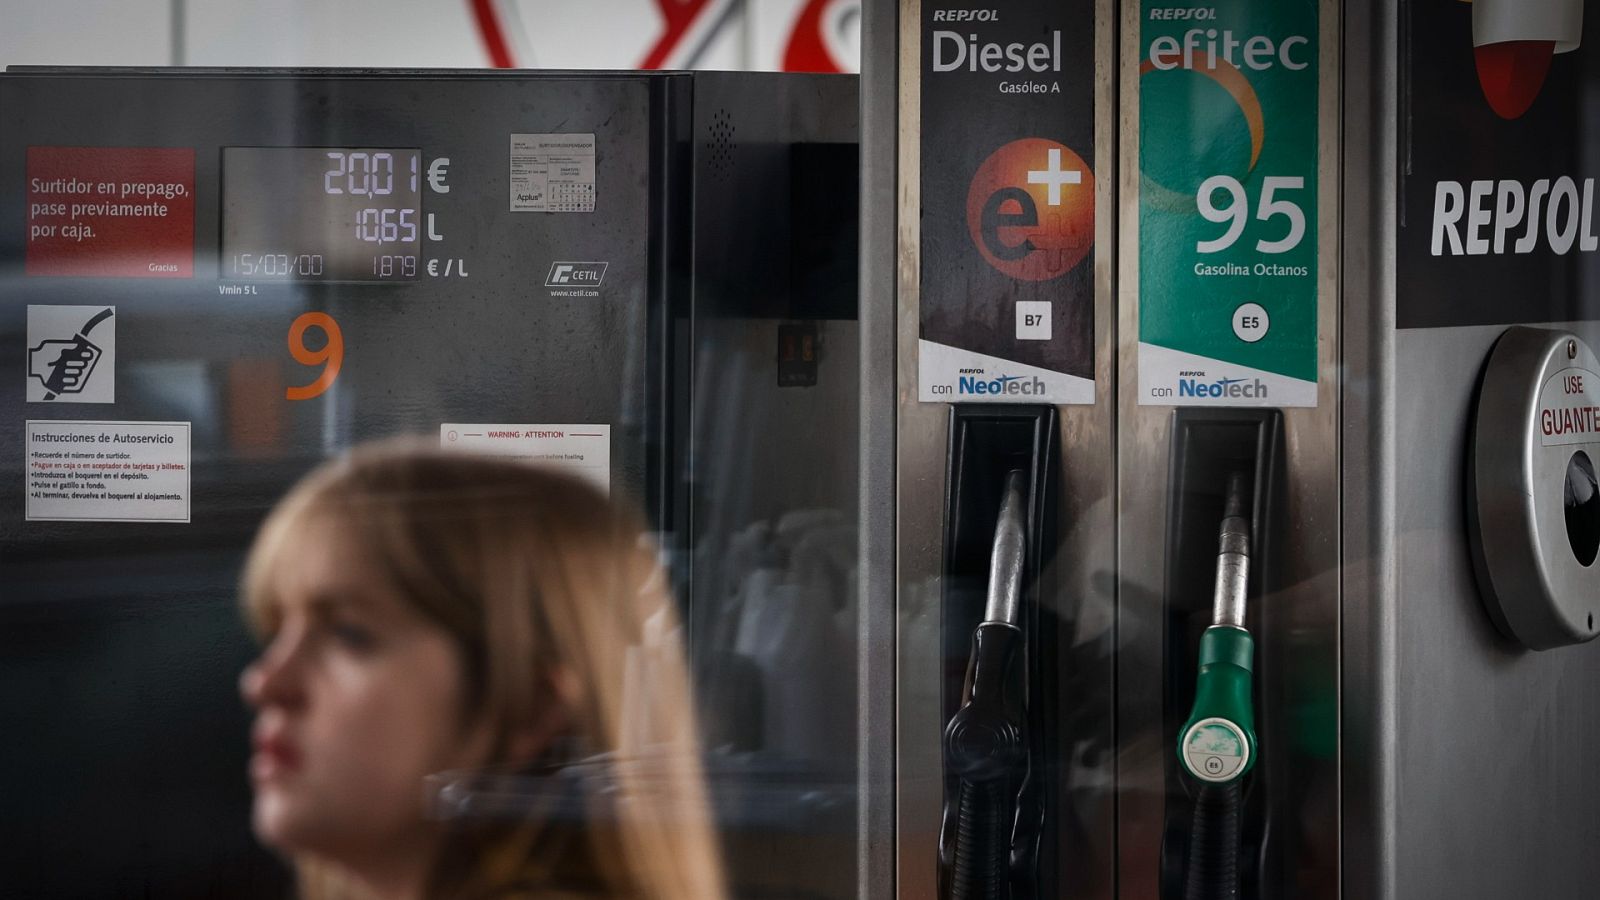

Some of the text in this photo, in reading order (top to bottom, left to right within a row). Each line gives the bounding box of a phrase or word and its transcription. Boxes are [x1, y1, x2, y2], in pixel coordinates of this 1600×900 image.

[933, 9, 999, 22] REPSOL
[1149, 8, 1216, 20] REPSOL
[932, 30, 1062, 73] Diesel
[1149, 29, 1309, 71] efitec
[999, 81, 1061, 94] Gasóleo A
[324, 152, 417, 200] 20,01
[427, 157, 450, 194] €
[31, 178, 189, 199] Surtidor en prepago,
[31, 201, 168, 219] pase previamente
[1196, 175, 1306, 254] 95
[1431, 175, 1599, 257] REPSOL
[31, 222, 96, 241] por caja.
[355, 208, 416, 246] 10,65
[427, 213, 443, 241] L
[149, 262, 178, 272] Gracias
[231, 254, 323, 276] 15/03/00
[373, 255, 416, 277] 1,879
[1194, 263, 1308, 276] Gasolina Octanos
[572, 270, 599, 281] CETIL
[219, 285, 242, 295] Vmin
[244, 285, 250, 295] 5
[1024, 314, 1043, 327] B7
[1241, 316, 1260, 329] E5
[286, 311, 344, 400] 9
[931, 385, 953, 395] con
[1563, 376, 1584, 395] USE
[1151, 387, 1173, 398] con
[32, 432, 174, 445] Instrucciones de Autoservicio
[71, 452, 95, 460] número
[34, 462, 53, 470] Pague
[92, 463, 122, 471] aceptador
[132, 463, 155, 471] tarjetas
[162, 463, 186, 471] billetes.
[75, 472, 102, 481] boquerel
[120, 472, 149, 481] depósito.
[60, 482, 79, 490] gatillo
[42, 492, 70, 500] terminar,
[108, 493, 135, 501] boquerel
[144, 493, 182, 501] alojamiento.
